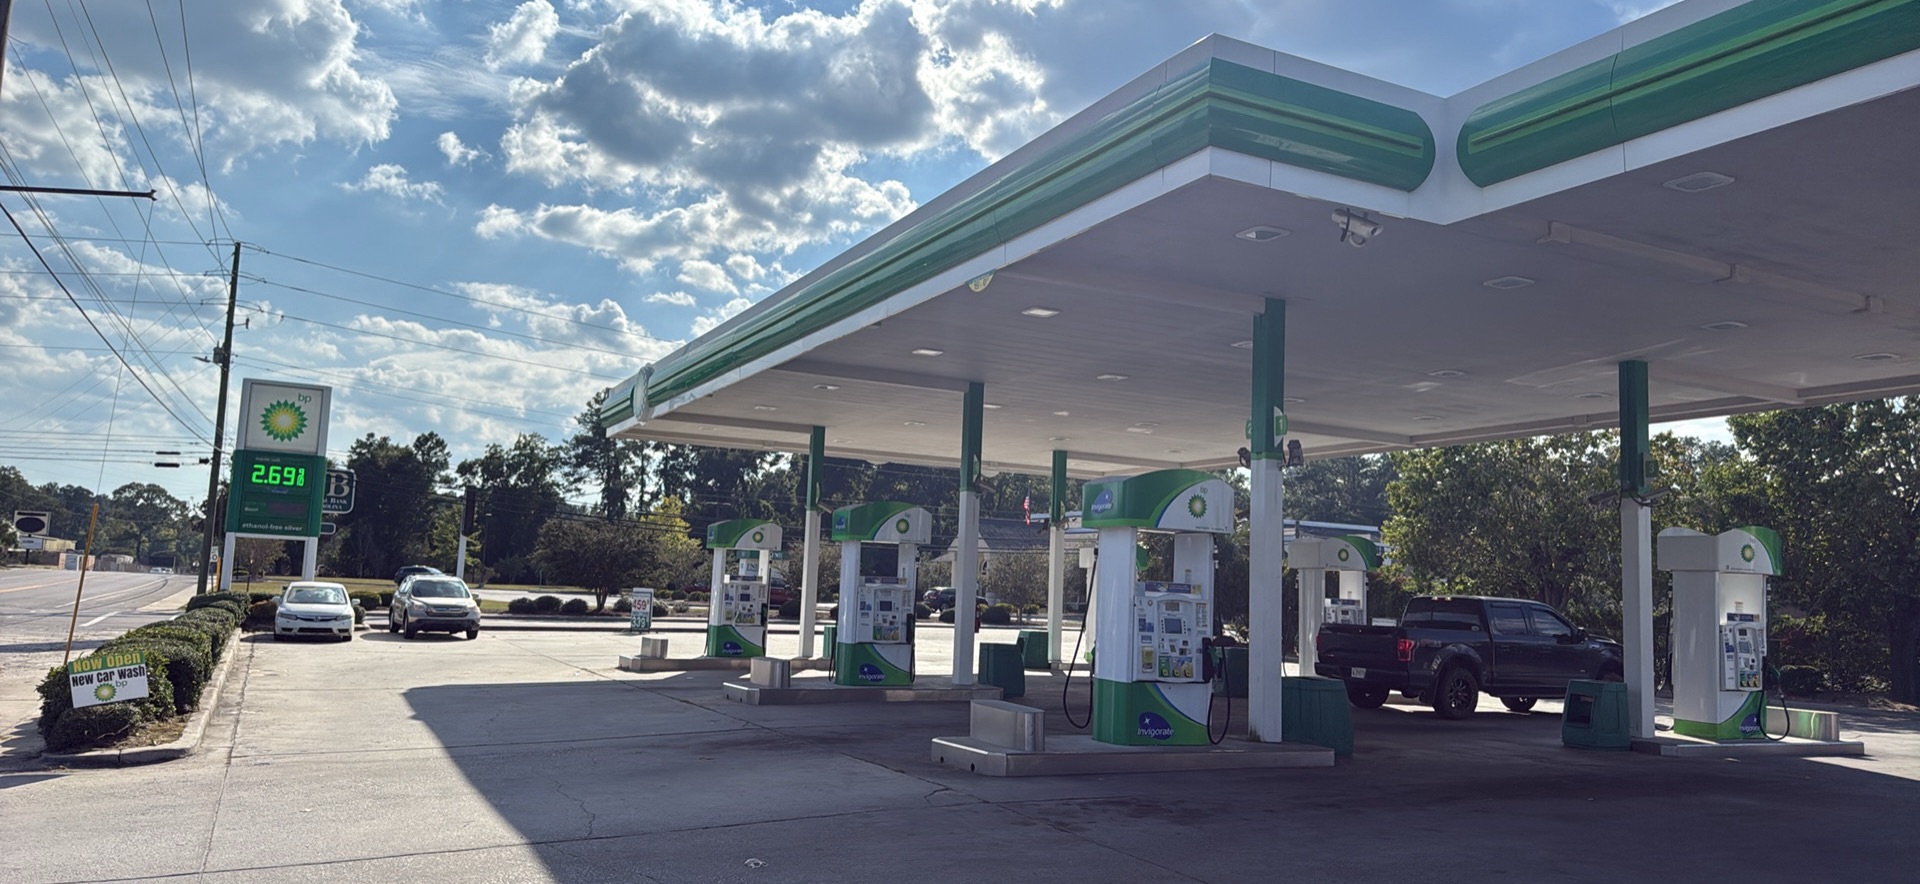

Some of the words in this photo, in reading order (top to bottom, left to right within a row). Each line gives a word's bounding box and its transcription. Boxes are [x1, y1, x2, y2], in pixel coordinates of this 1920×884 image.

[298, 392, 312, 404] bp
[1279, 418, 1283, 431] 1
[1200, 486, 1209, 496] bp
[242, 522, 283, 530] ethanol-free
[284, 524, 303, 532] silver
[73, 657, 102, 673] Now
[106, 652, 141, 668] Open
[71, 674, 94, 688] New
[117, 665, 146, 680] Wash
[115, 680, 128, 688] bp
[1137, 726, 1175, 738] Invigorate
